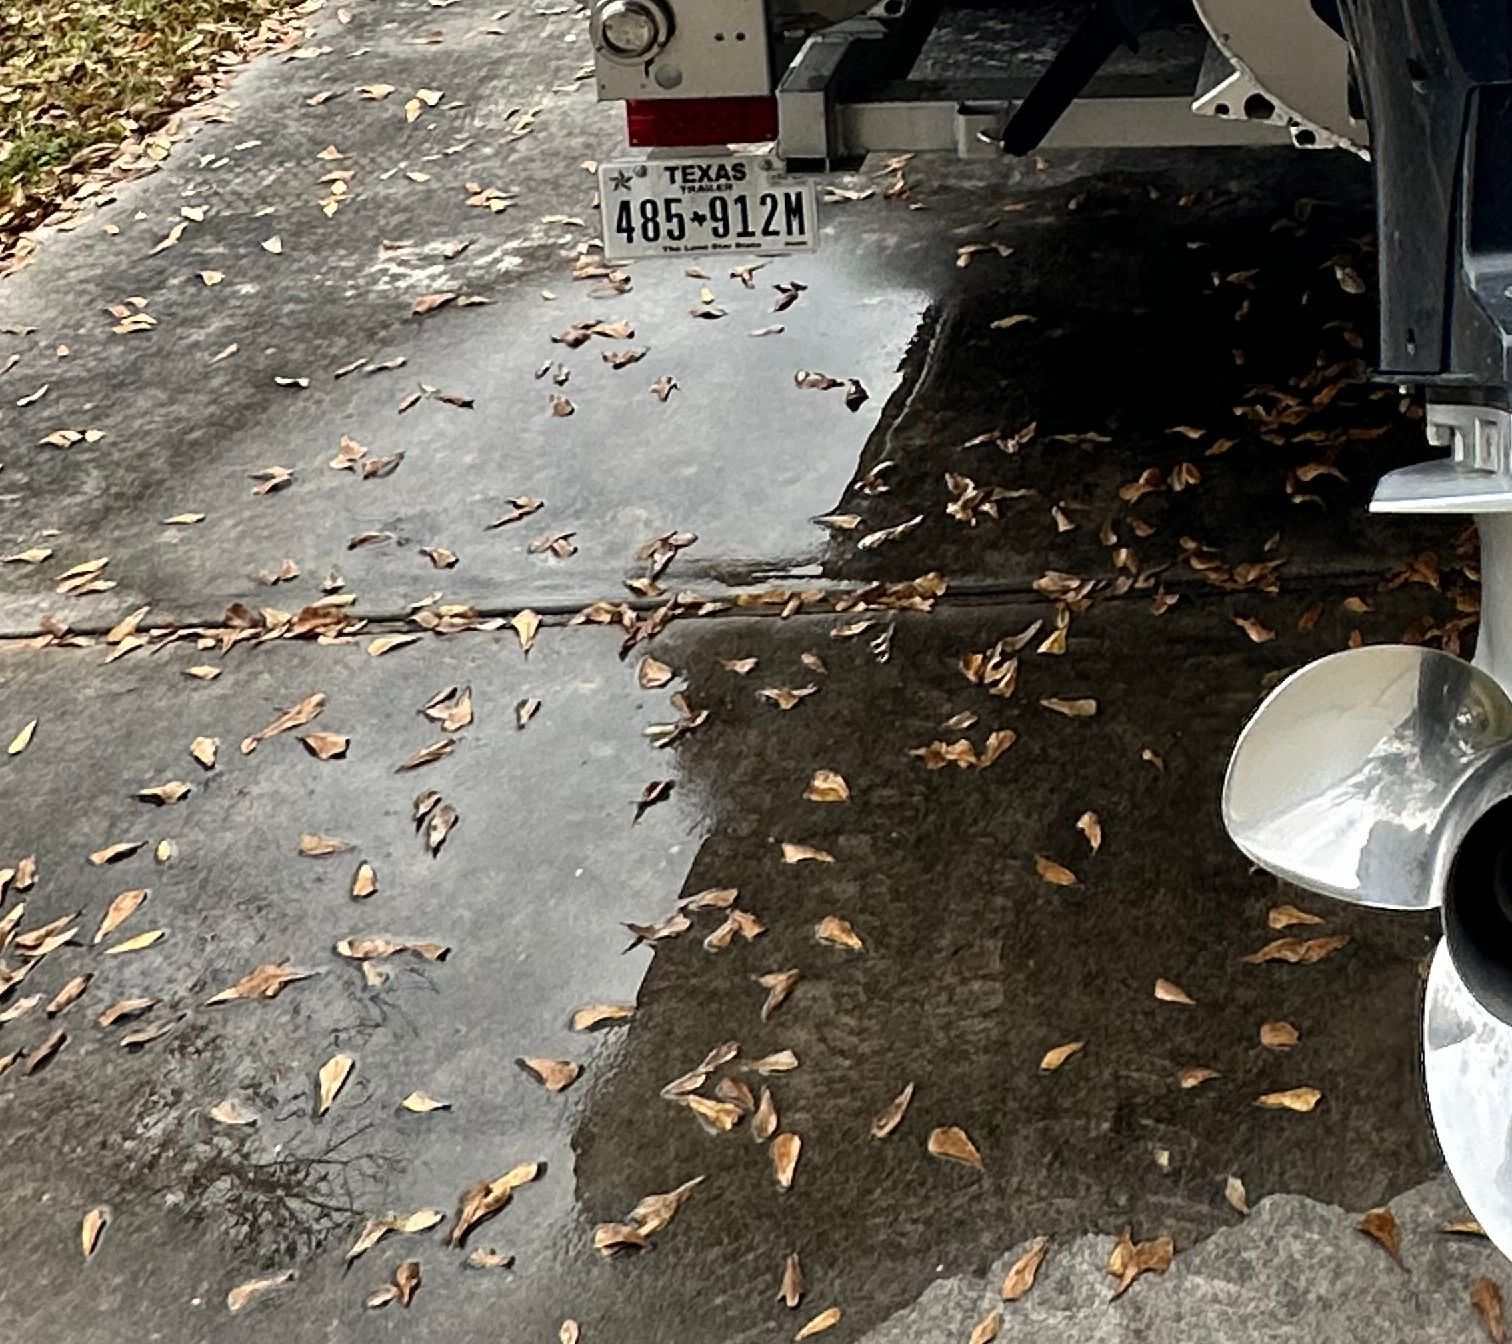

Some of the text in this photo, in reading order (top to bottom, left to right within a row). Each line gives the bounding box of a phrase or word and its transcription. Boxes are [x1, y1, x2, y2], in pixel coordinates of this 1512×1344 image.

[664, 162, 747, 185] TEXAS
[680, 182, 734, 194] TRAILER
[616, 191, 806, 244] 485 912M
